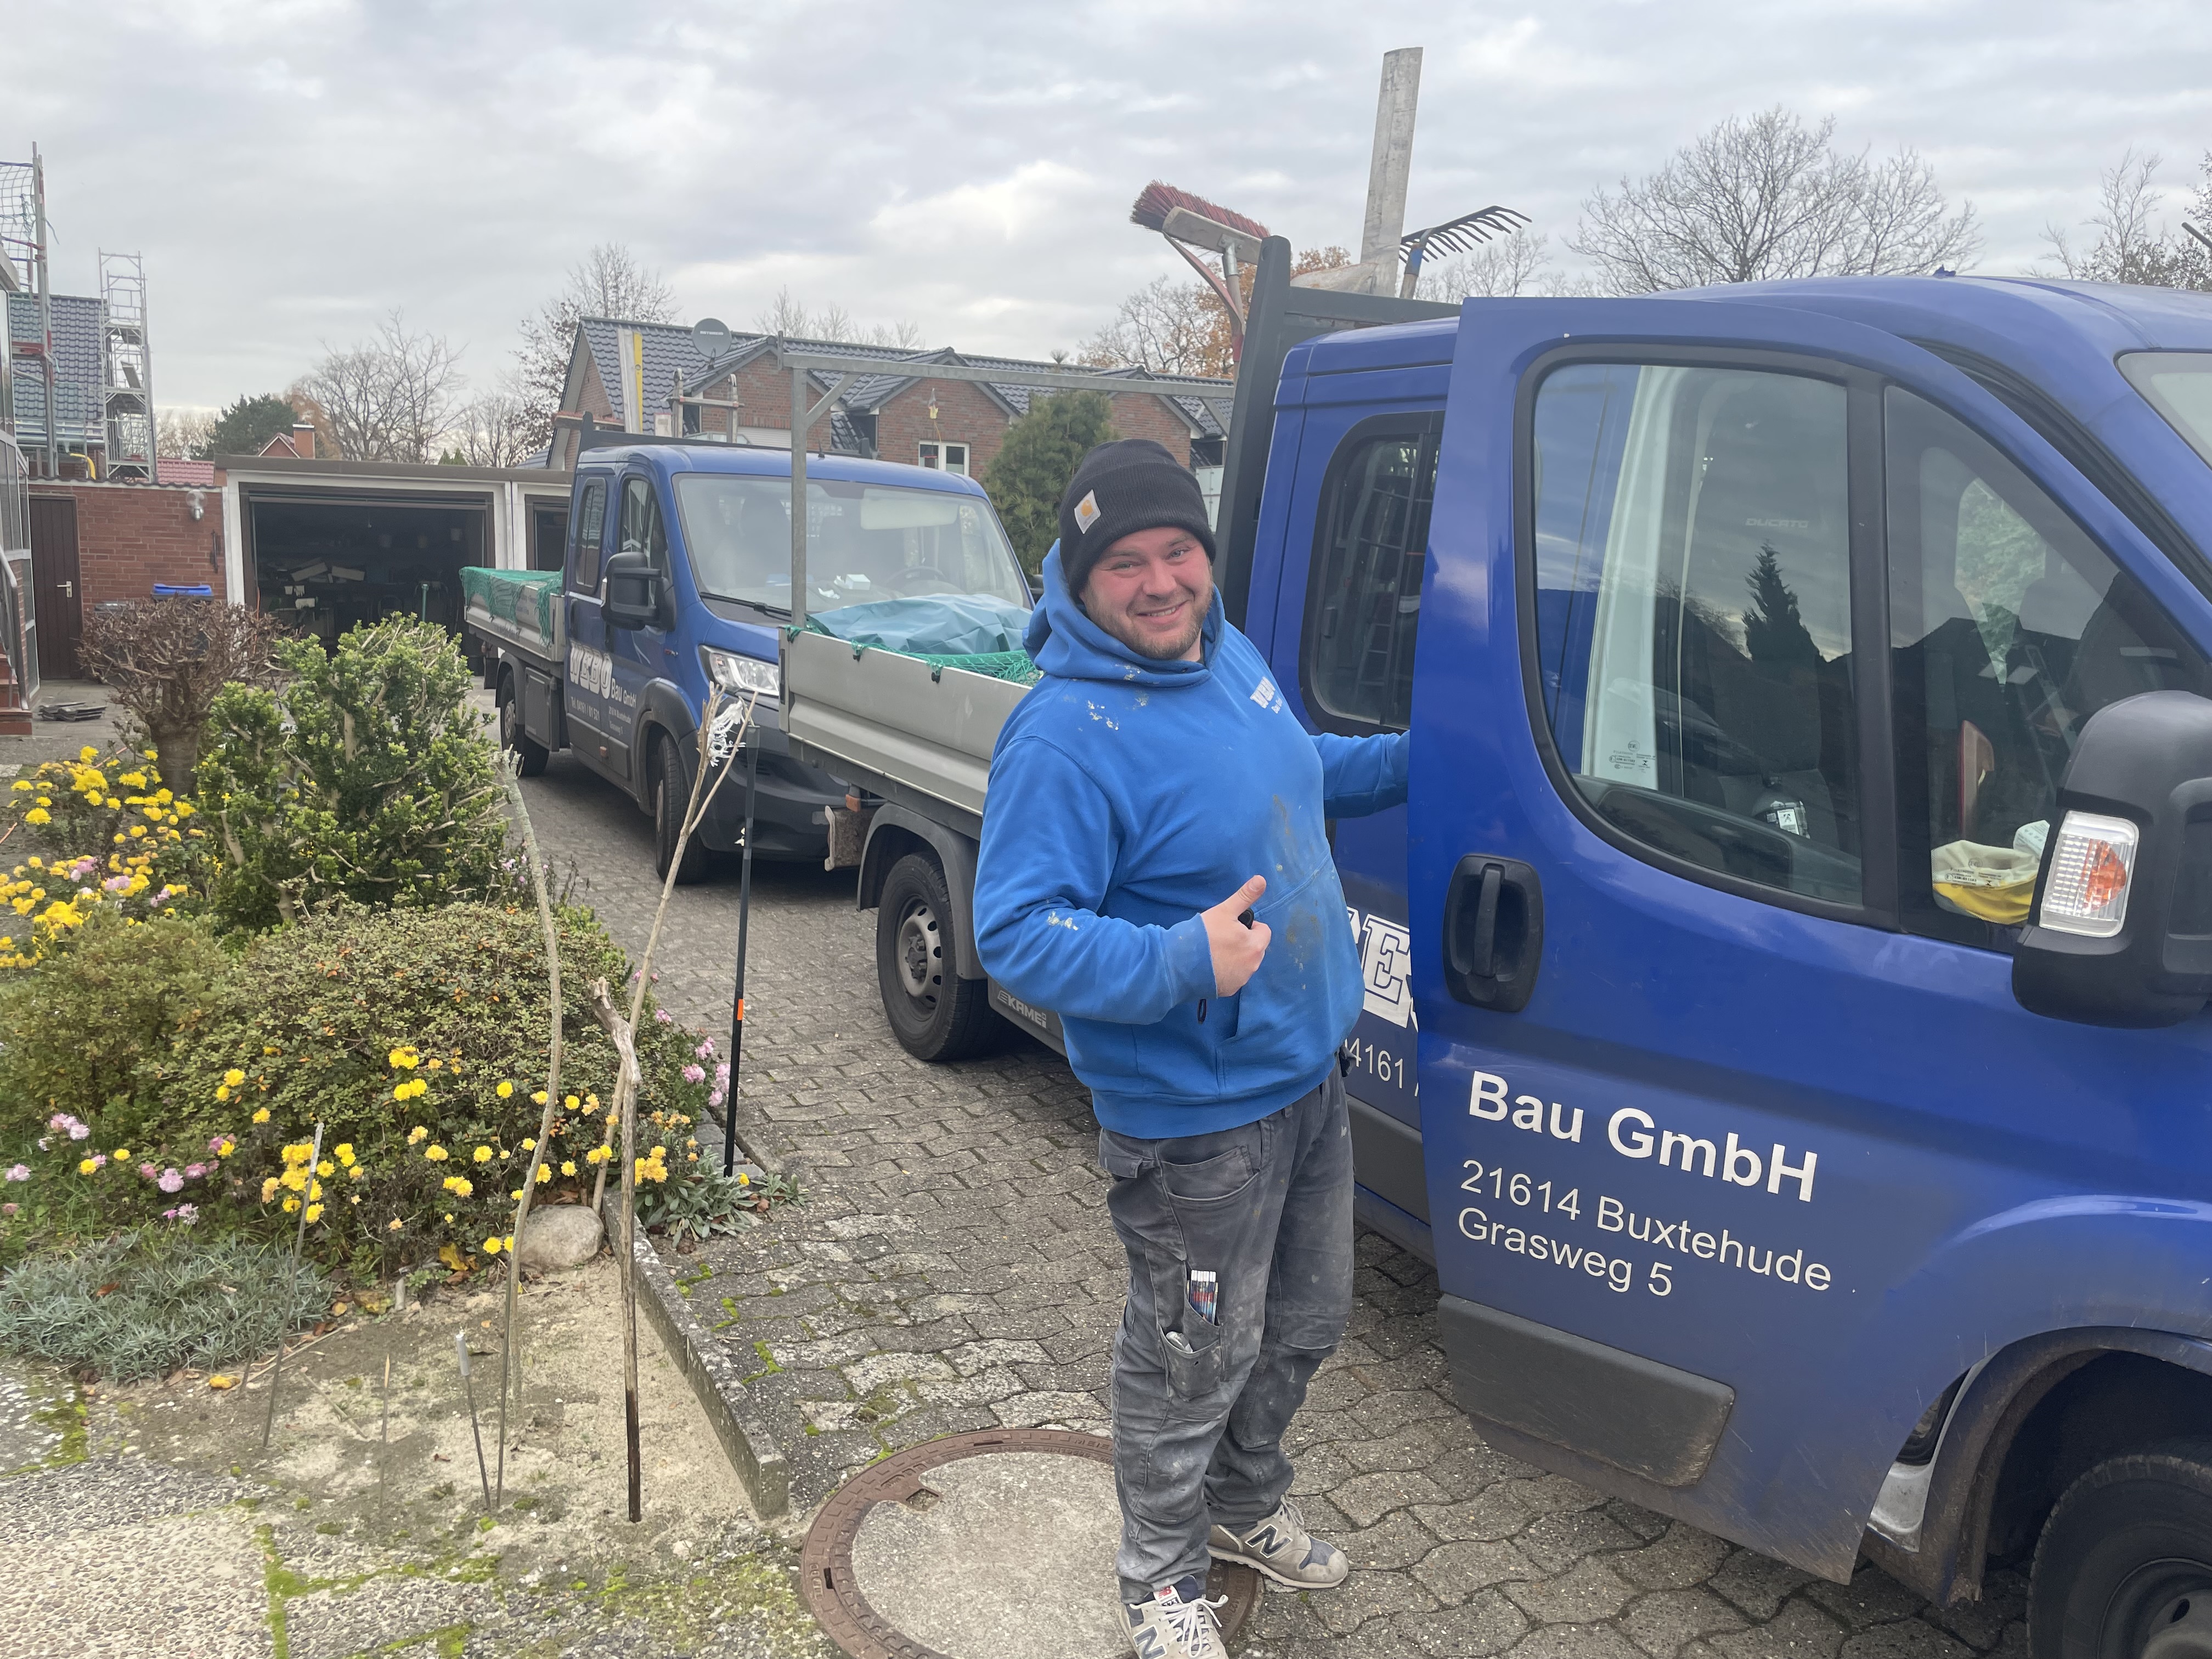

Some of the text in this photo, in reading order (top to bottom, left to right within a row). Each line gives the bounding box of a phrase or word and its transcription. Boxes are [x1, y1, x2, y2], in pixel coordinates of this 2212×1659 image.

[1745, 518, 1809, 528] DUCATO
[569, 639, 613, 699] WEBO
[611, 678, 623, 702] Bau
[1008, 995, 1047, 1029] KAMEI
[1345, 1037, 1403, 1089] 4161
[1469, 1070, 1818, 1202] Bau GmbH
[1460, 1159, 1831, 1291] 21614 Buxtehude
[1458, 1207, 1673, 1296] Grasweg 5
[1075, 1438, 1113, 1452] MEIE
[1244, 1523, 1294, 1559] N
